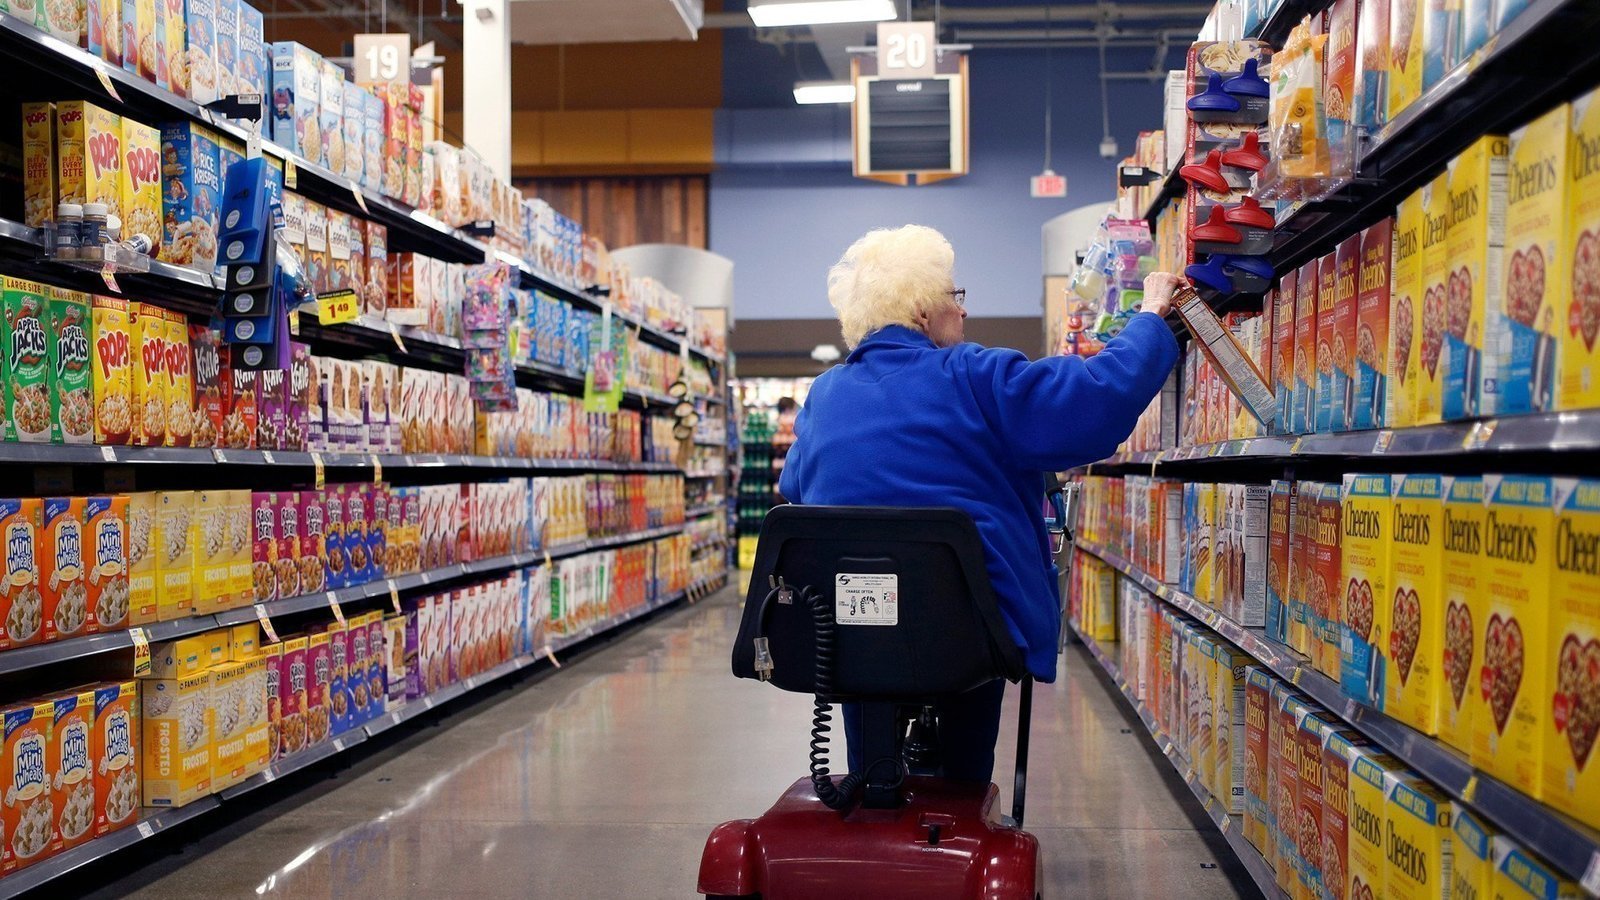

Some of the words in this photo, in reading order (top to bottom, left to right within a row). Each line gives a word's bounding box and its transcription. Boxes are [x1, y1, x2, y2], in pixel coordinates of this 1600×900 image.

[366, 44, 398, 80] 19
[886, 33, 926, 68] 20
[26, 112, 47, 127] POPS
[60, 111, 82, 126] POPS
[88, 133, 119, 180] POPS
[200, 152, 214, 172] RICE
[62, 169, 83, 177] BITE
[126, 147, 161, 193] POPS
[194, 167, 219, 192] KRISPIES
[1510, 154, 1557, 206] Cheerios
[7, 279, 27, 291] LARGE
[28, 283, 41, 294] SIZE
[52, 289, 71, 300] LARGE
[72, 292, 83, 302] SIZE
[17, 318, 39, 333] APPLE
[62, 327, 82, 339] APPLE
[11, 328, 46, 370] JACKS
[57, 336, 88, 376] JACKS
[97, 331, 130, 380] POPS
[142, 338, 165, 385] POPS
[165, 342, 188, 387] POPS
[1355, 478, 1371, 493] FAMILY
[1372, 478, 1385, 493] SIZE
[1345, 501, 1380, 539] Cheerios
[1393, 503, 1430, 545] Cheerios
[1443, 509, 1480, 555] Cheerios
[9, 536, 31, 558] Mini
[59, 533, 79, 555] Mini
[100, 531, 120, 552] Mini
[1485, 511, 1537, 564] Cheerios
[1557, 518, 1600, 576] Cheer
[8, 553, 32, 575] Wheats
[57, 550, 79, 571] Wheats
[98, 547, 121, 566] Wheats
[221, 668, 236, 680] FAMILY
[237, 665, 245, 676] SIZE
[246, 660, 258, 671] FAMILY
[185, 677, 200, 689] FAMILY
[200, 676, 209, 685] SIZE
[64, 734, 85, 758] Mini
[108, 722, 127, 746] Mini
[18, 747, 42, 773] Mini
[106, 739, 128, 761] Wheats
[160, 722, 170, 777] FROSTED
[183, 750, 209, 771] FROSTED
[218, 739, 244, 760] FROSTED
[63, 752, 86, 775] Wheats
[1299, 746, 1323, 788] Cheerio
[1356, 759, 1371, 780] GIANT
[16, 766, 43, 791] Wheats
[1324, 767, 1348, 816] Cheerios
[1396, 787, 1413, 810] GIANT
[1413, 800, 1428, 819] SIZE
[1351, 791, 1381, 848] Cheerios
[1386, 819, 1427, 885] Cheerios
